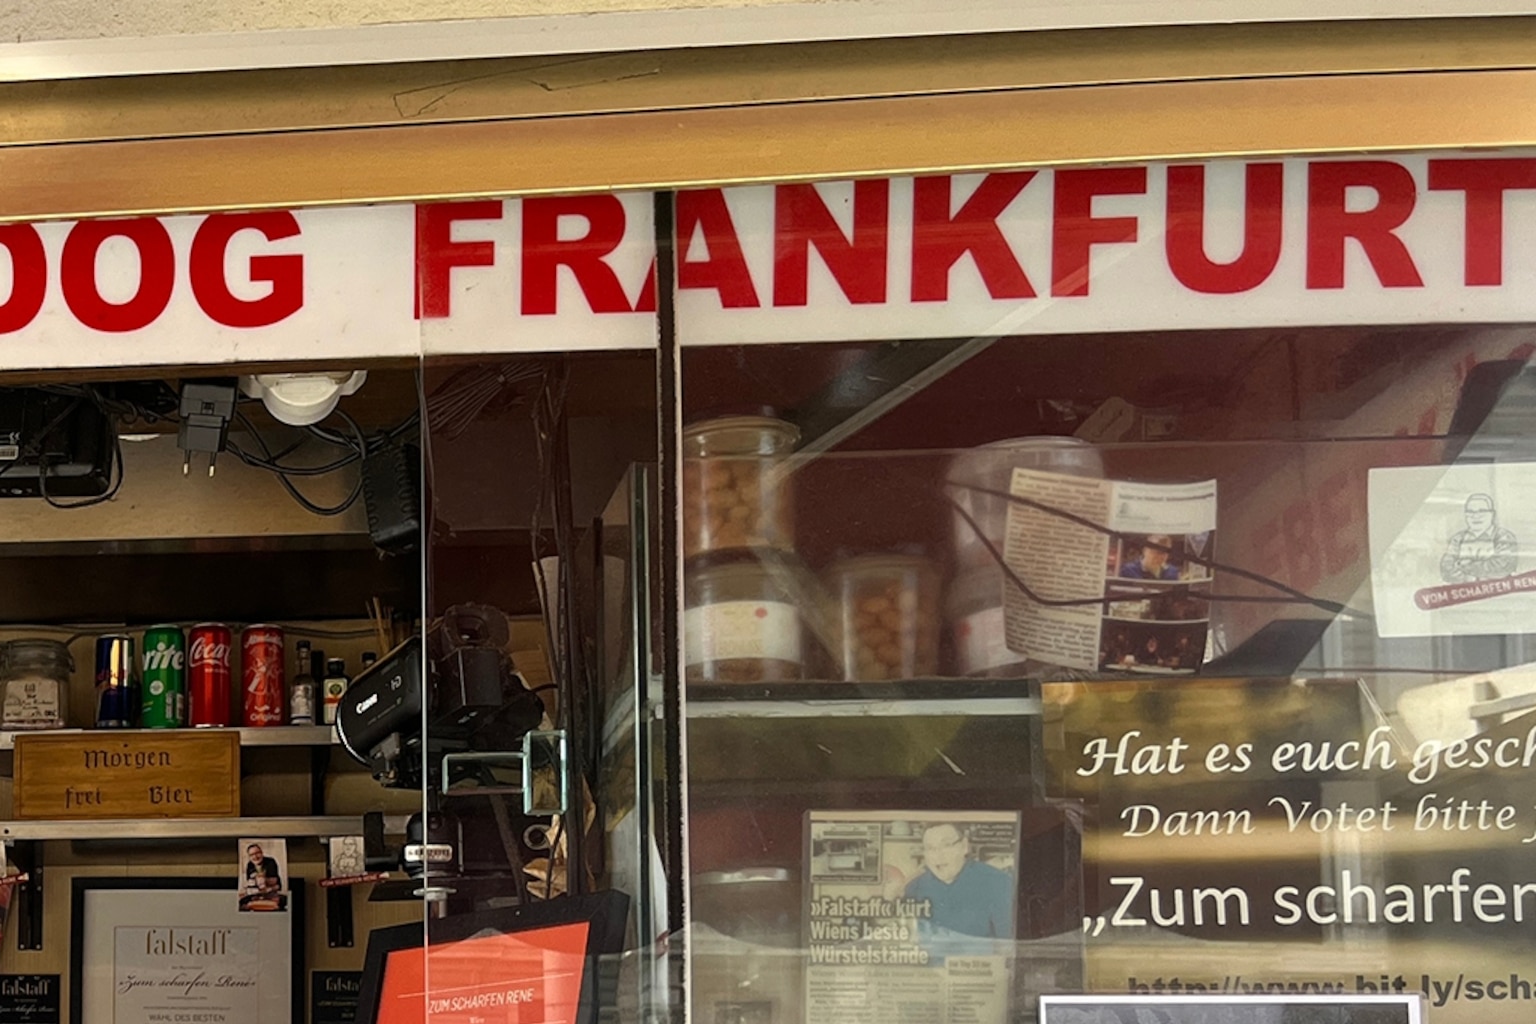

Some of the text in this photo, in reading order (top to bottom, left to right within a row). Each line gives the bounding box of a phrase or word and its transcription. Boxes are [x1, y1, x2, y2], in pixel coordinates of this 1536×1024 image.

[414, 157, 1536, 320] FRANKFURT
[1422, 581, 1512, 605] VOM SCHARFEN
[84, 750, 171, 768] Morgen
[1077, 729, 1186, 777] Hat
[1205, 742, 1253, 774] es
[1271, 726, 1397, 773] euch
[65, 786, 193, 809] frei Bier
[1121, 802, 1255, 838] Dann
[1267, 797, 1398, 836] Votet
[1413, 793, 1517, 831] bitte
[811, 898, 931, 918] »Falstaff« kürt
[810, 920, 909, 941] Wiens beste
[145, 929, 231, 956] falstaff
[810, 944, 929, 964] Würstelstände
[2, 978, 51, 996] falstaff
[429, 988, 536, 1014] ZUM SCHARFEN RENE
[149, 1014, 226, 1022] WAHL DES BESTEN
